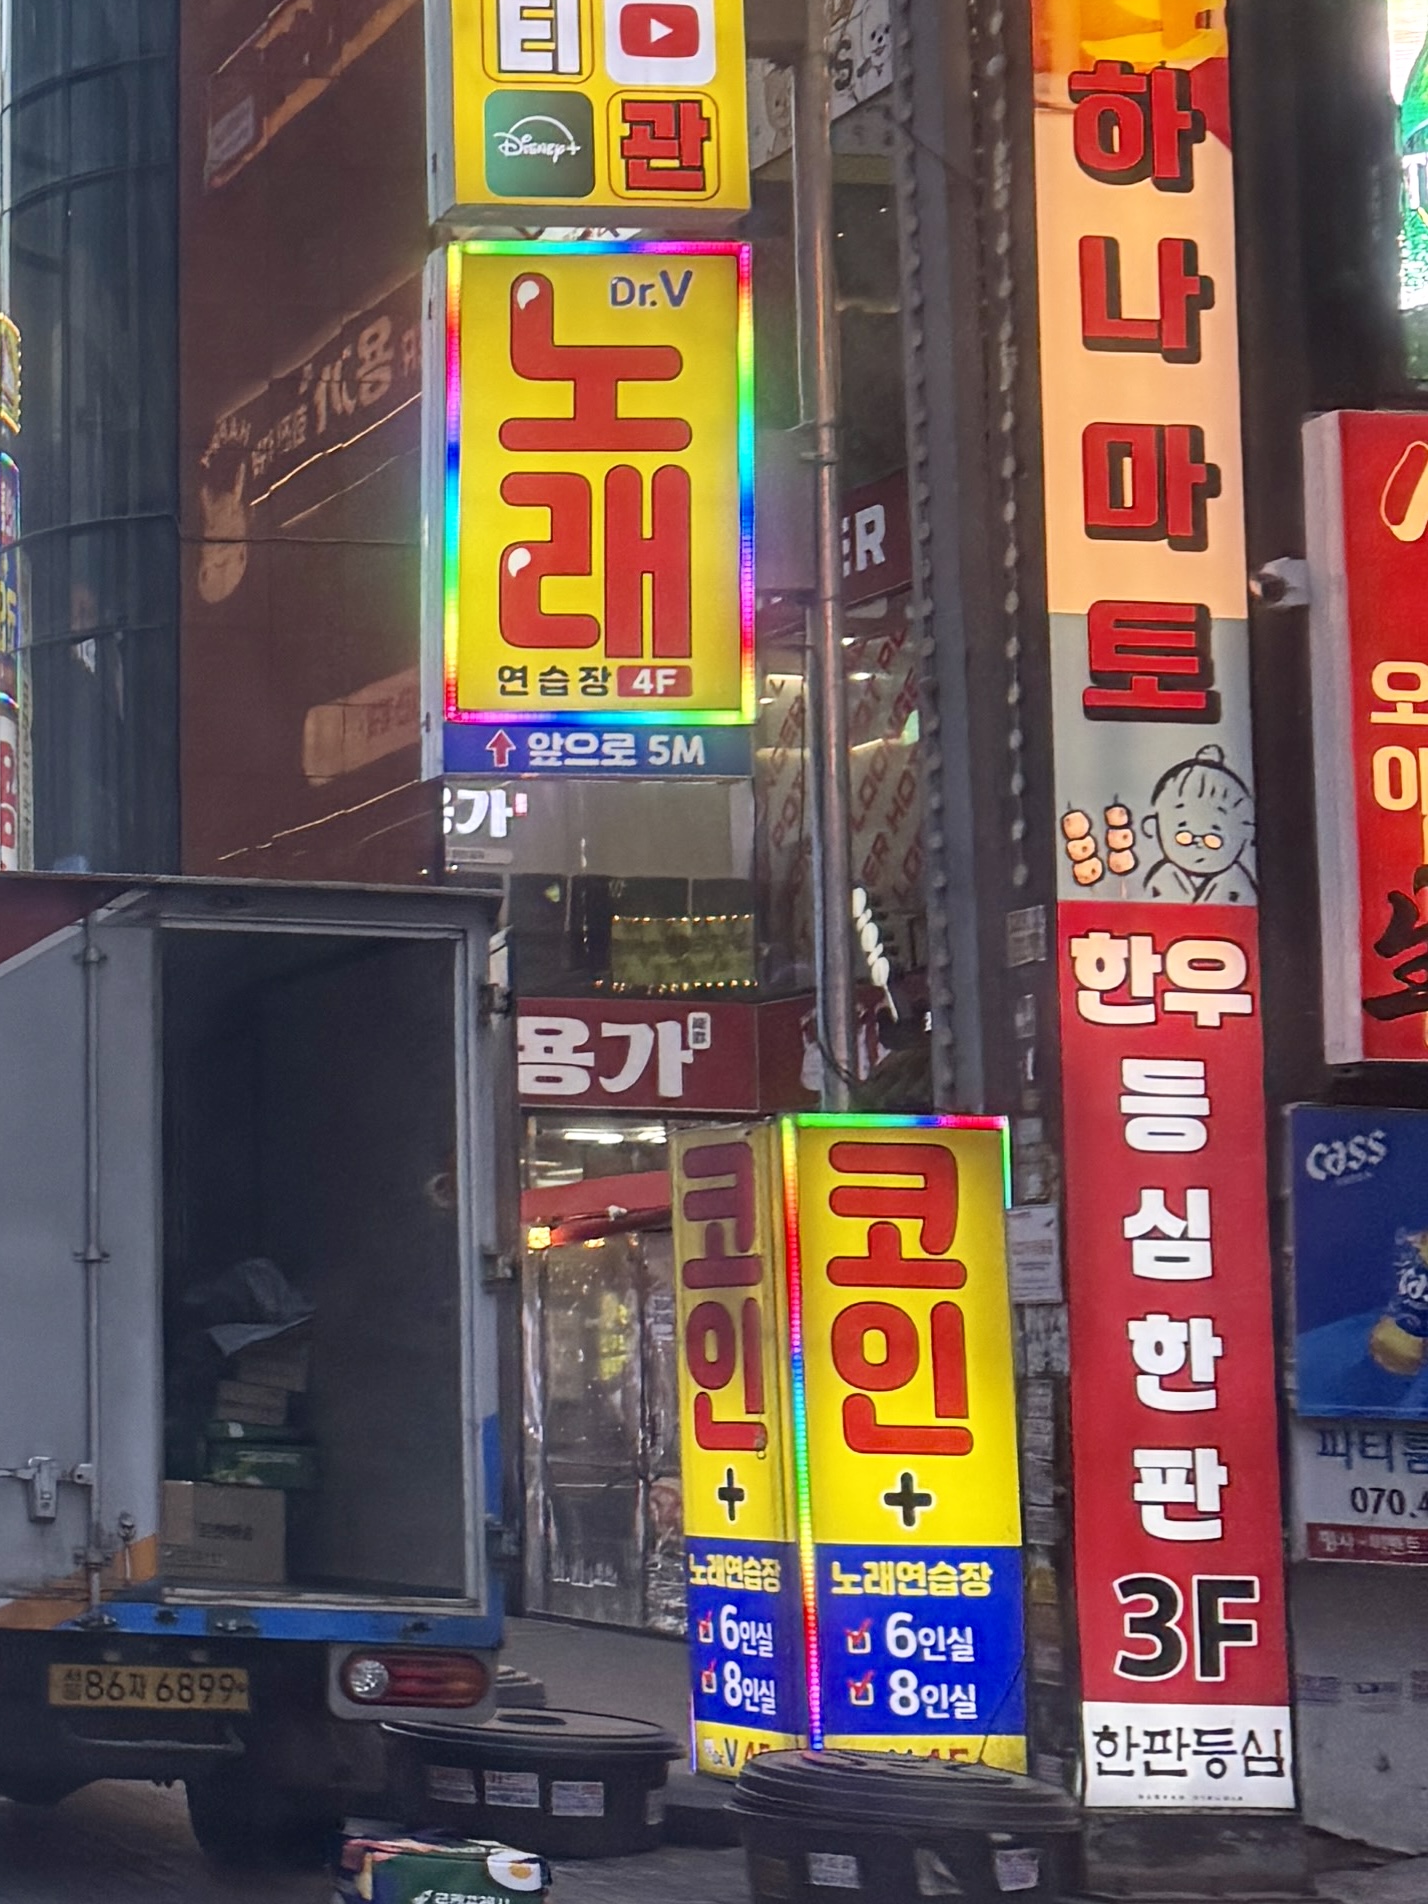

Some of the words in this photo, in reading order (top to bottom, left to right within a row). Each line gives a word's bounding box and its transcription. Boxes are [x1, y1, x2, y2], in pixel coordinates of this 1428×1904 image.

[609, 270, 693, 309] Dr.V
[498, 272, 693, 659] 노래
[498, 666, 610, 698] 연습장
[630, 669, 678, 694] 4F
[528, 732, 638, 767] 앞으로
[647, 733, 706, 767] 5M
[1070, 930, 1253, 1028] 한우
[681, 1141, 769, 1456] 코인
[827, 1141, 974, 1456] 코인
[1118, 1058, 1228, 1543] 등심한판
[689, 1552, 782, 1593] 노래연습장
[830, 1560, 993, 1598] 노래연습장
[719, 1604, 774, 1659] 6인실
[884, 1612, 976, 1664] 6인실
[1113, 1574, 1260, 1684] 3F
[722, 1661, 777, 1716] 8인실
[888, 1669, 979, 1721] 8인실
[1091, 1724, 1285, 1780] 한판등심
